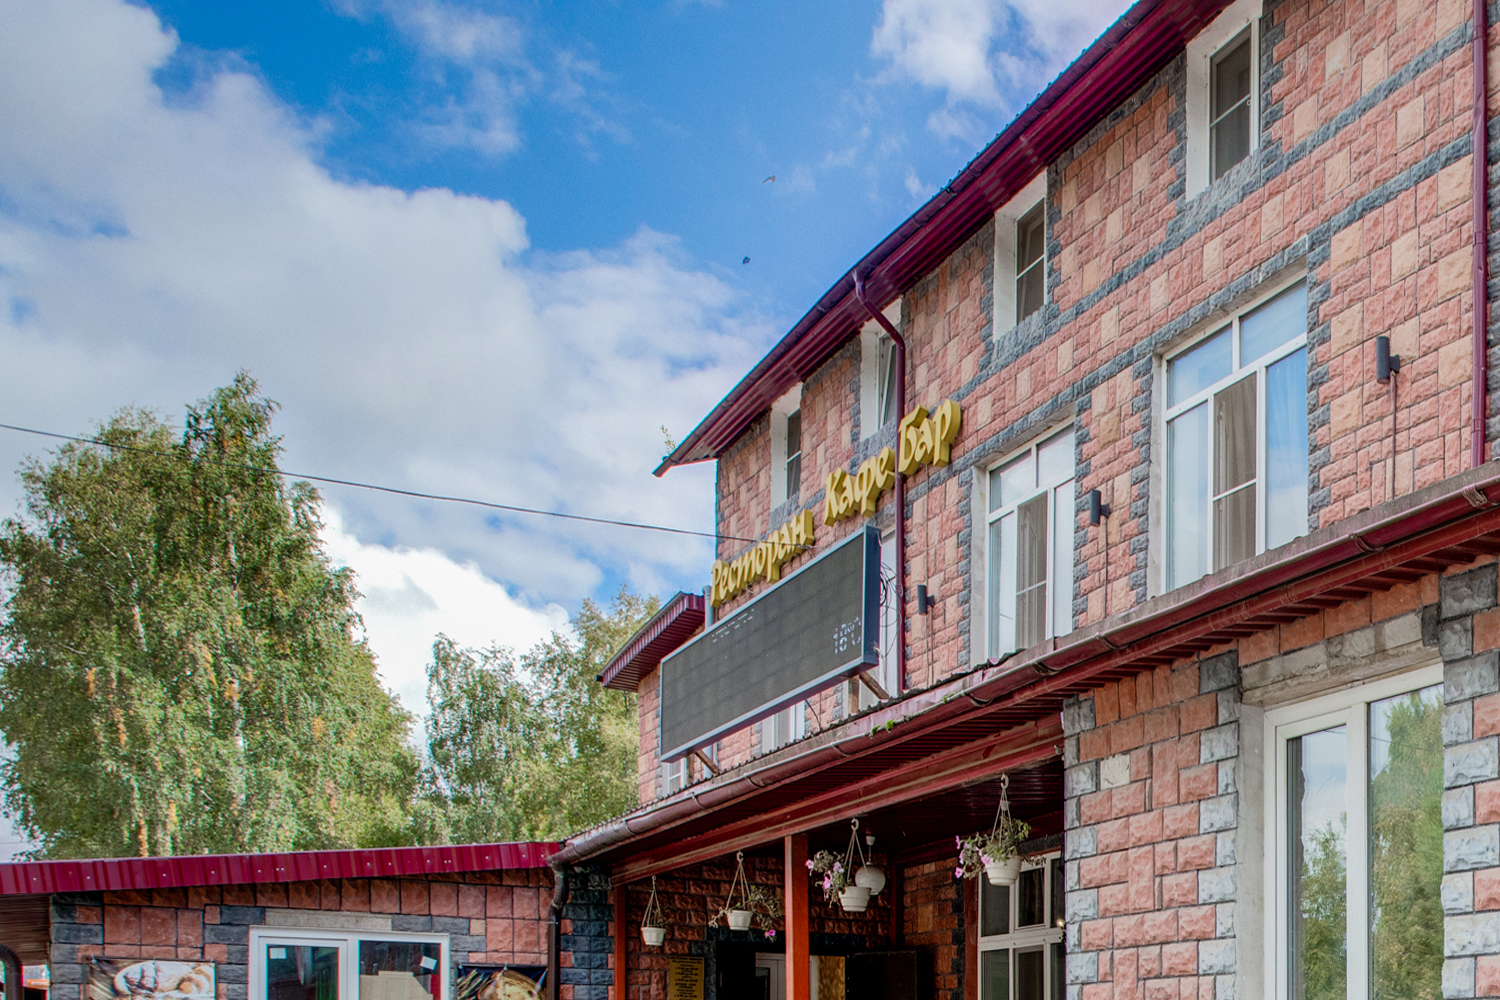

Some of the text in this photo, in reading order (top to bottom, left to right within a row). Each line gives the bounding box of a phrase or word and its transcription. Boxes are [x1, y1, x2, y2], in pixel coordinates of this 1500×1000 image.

[710, 398, 961, 608] Ресторан Кафе Бар
